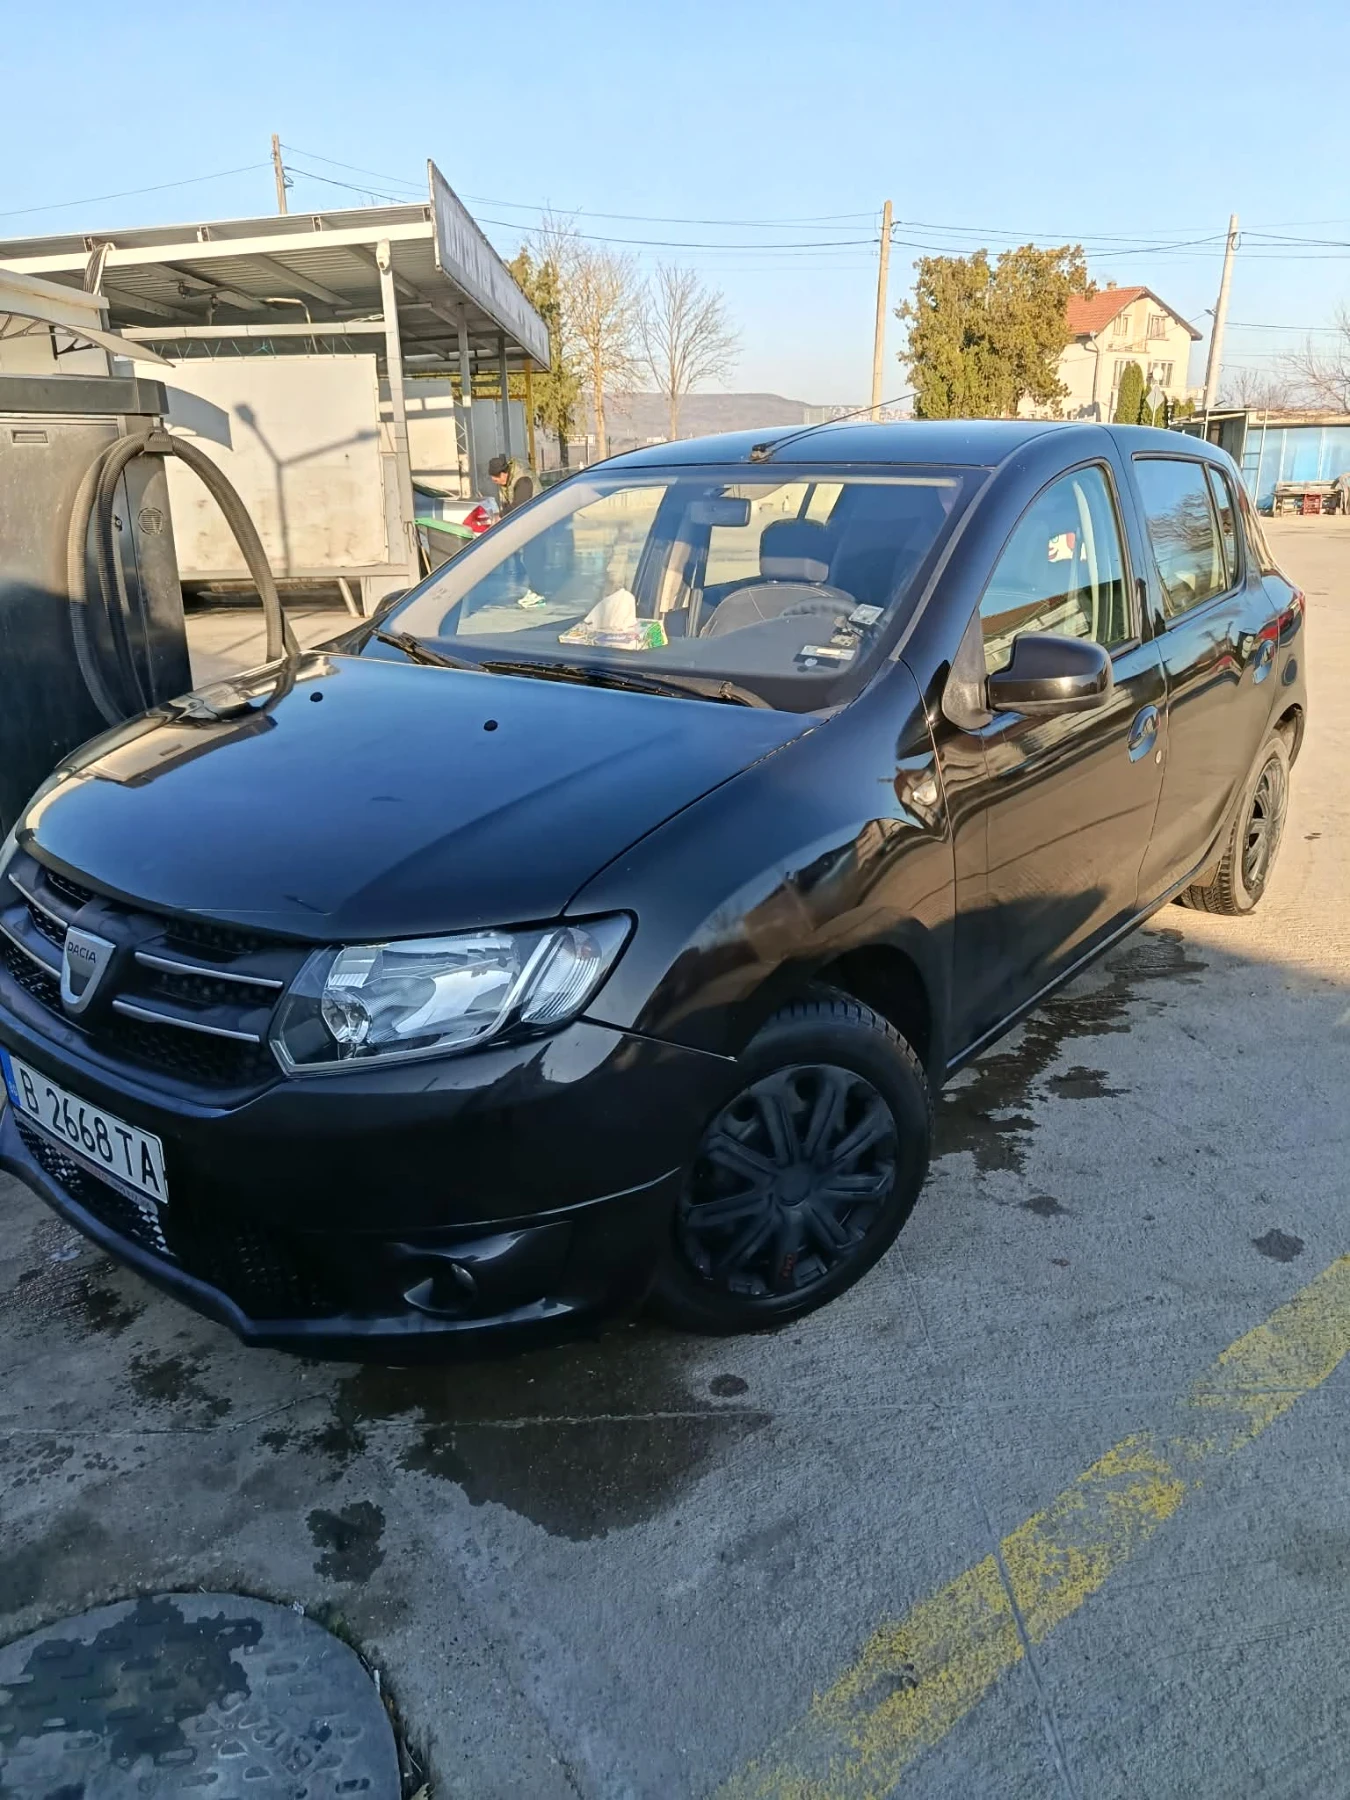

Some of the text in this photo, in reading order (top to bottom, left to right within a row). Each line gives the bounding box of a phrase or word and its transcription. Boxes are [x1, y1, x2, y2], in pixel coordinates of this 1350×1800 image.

[68, 942, 96, 963] DACIA
[20, 1068, 39, 1114] B
[46, 1088, 113, 1163] 2668
[115, 1126, 161, 1192] TA
